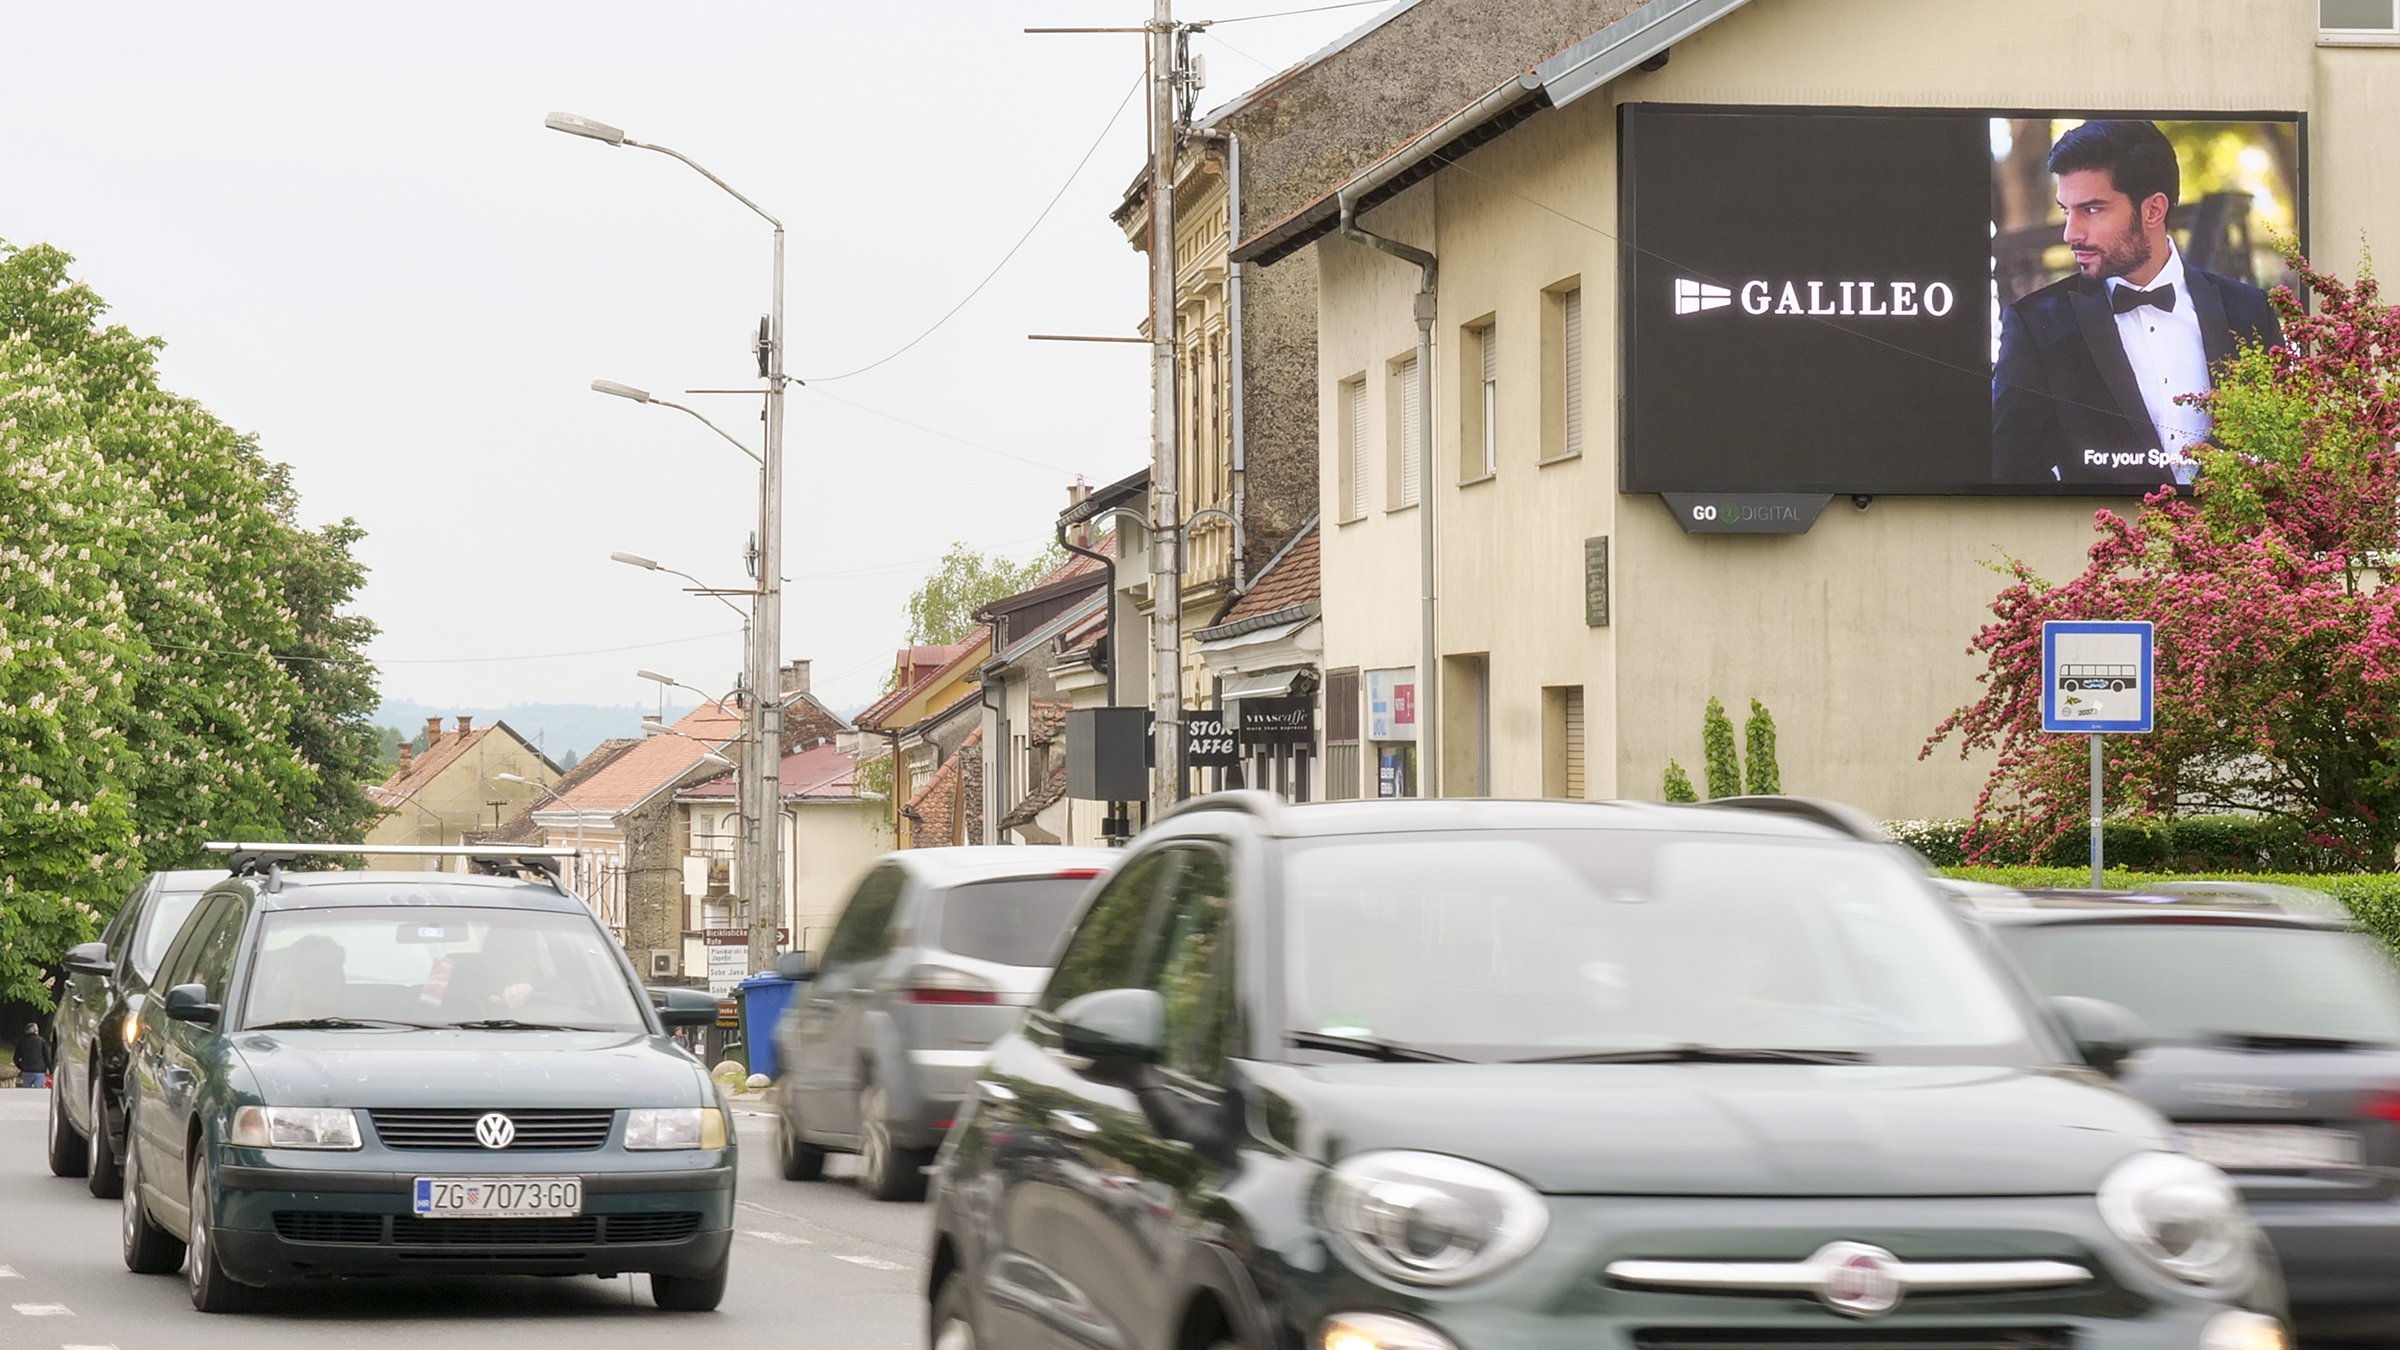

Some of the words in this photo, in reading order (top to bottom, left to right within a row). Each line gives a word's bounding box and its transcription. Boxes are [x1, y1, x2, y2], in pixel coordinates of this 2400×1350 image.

[1741, 280, 1954, 317] GALILEO
[2084, 449, 2109, 465] For
[2112, 453, 2146, 468] your
[1692, 505, 1717, 521] GO
[1742, 505, 1801, 521] DIGITAL
[1188, 738, 1234, 754] AFFE
[706, 937, 722, 945] Rute
[434, 1183, 464, 1209] ZG
